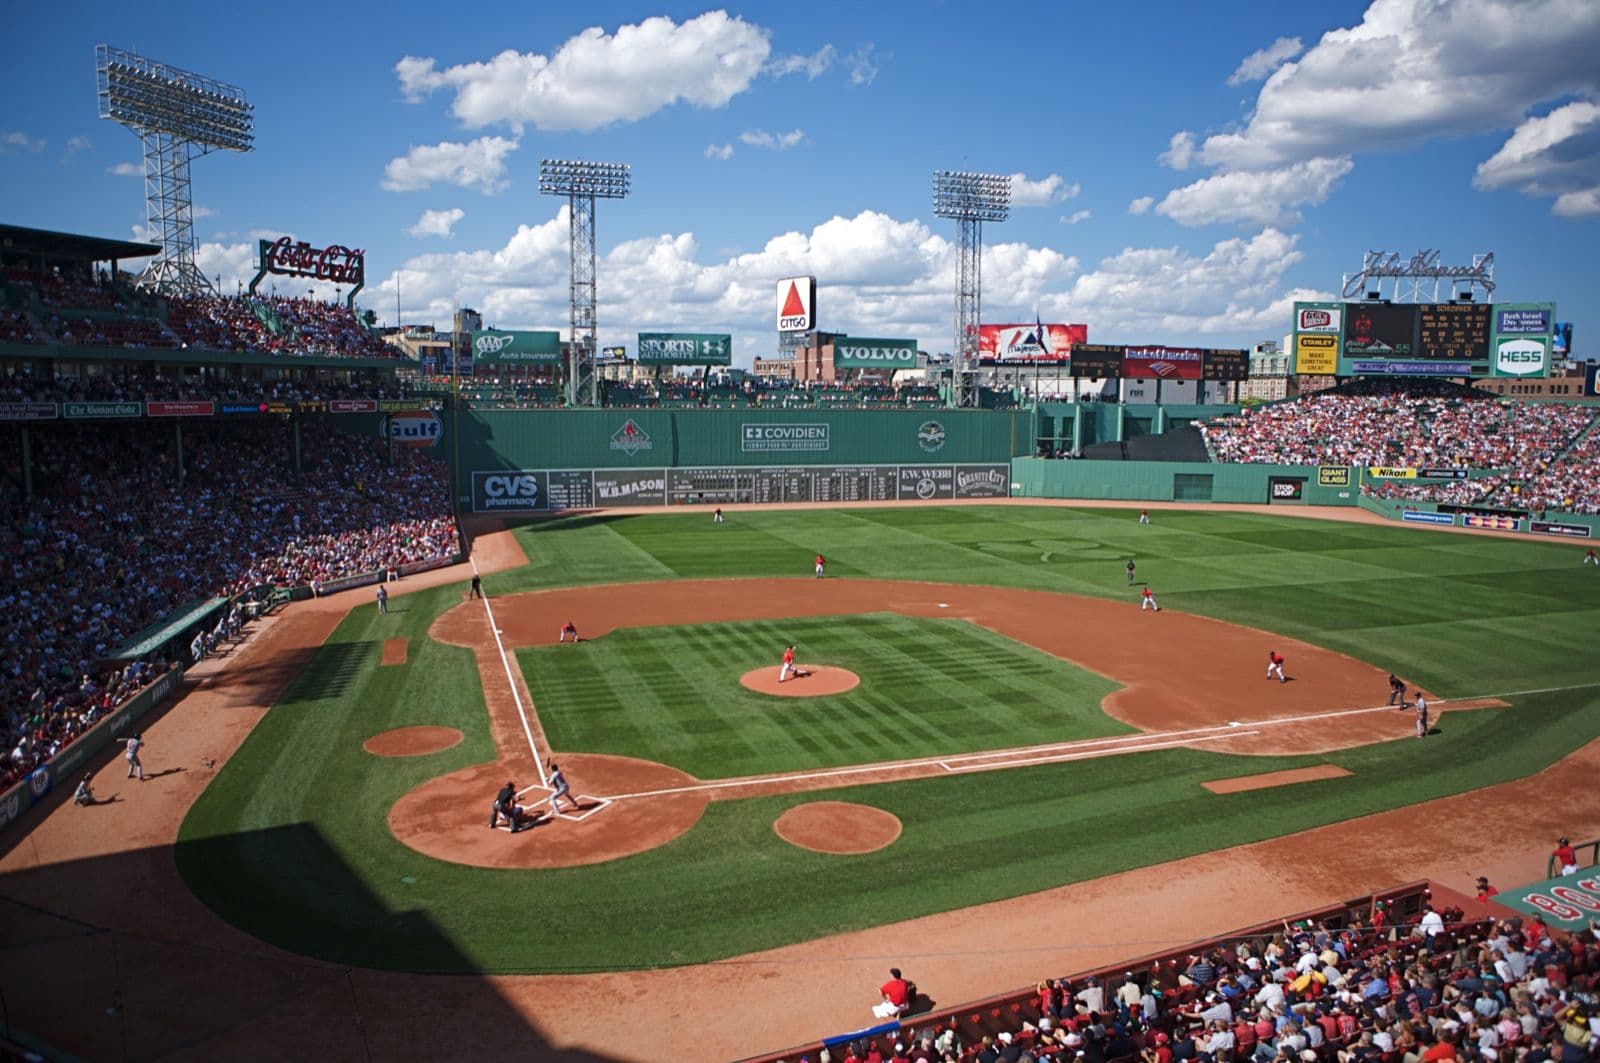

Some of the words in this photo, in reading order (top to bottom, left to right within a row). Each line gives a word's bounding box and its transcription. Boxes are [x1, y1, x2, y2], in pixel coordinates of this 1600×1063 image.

[267, 236, 366, 284] Coca-Cola
[780, 317, 806, 328] CITGO
[481, 336, 501, 352] AAA
[641, 340, 694, 351] SPORTS
[642, 351, 694, 360] AUTHORITY
[840, 346, 913, 360] VOLVO
[1500, 351, 1541, 362] HESS
[391, 421, 440, 437] Gulf
[765, 427, 825, 438] COVIDIEN
[921, 468, 952, 479] WEBB
[1378, 469, 1407, 478] Nikon
[485, 475, 538, 497] CVS
[486, 497, 537, 509] pharmacy
